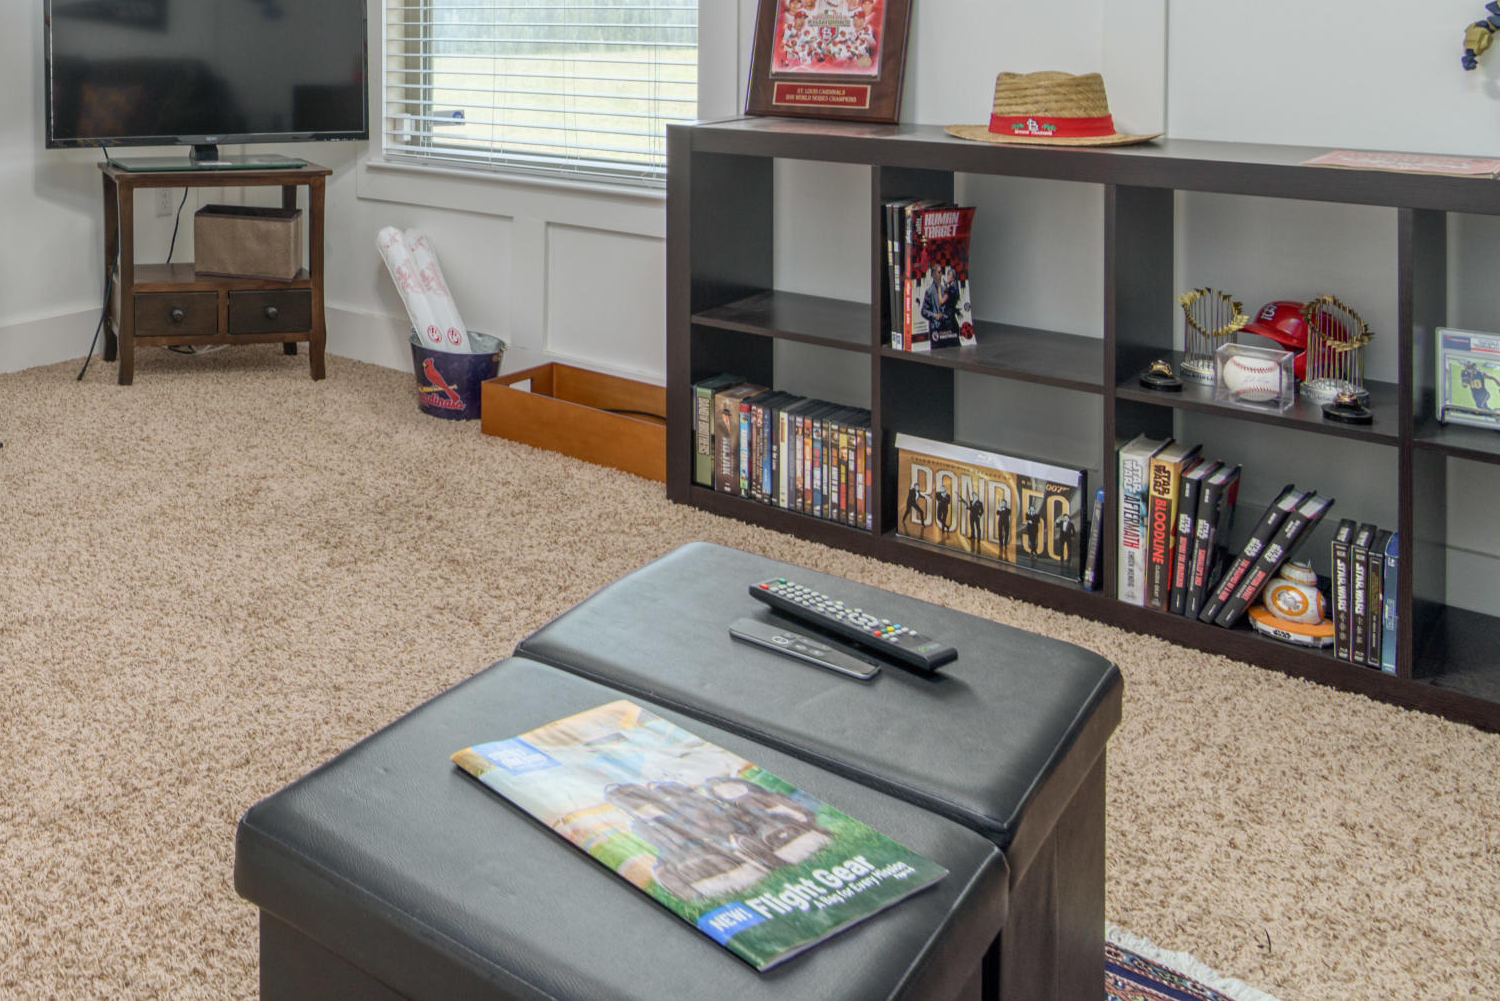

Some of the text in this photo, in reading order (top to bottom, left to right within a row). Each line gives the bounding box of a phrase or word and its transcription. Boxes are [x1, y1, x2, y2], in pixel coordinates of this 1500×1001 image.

[924, 212, 959, 226] HUMAN
[924, 225, 957, 238] TARGET
[1123, 460, 1133, 493] WARS
[1132, 461, 1142, 494] STAR
[1153, 464, 1163, 496] WARS
[1161, 467, 1171, 496] STAR
[910, 462, 1011, 544] BOND
[1021, 488, 1070, 561] 50
[1123, 495, 1140, 549] AFTERMATH
[1152, 499, 1167, 564] BLOODLINE
[1337, 559, 1347, 612] STAR WARS
[1355, 562, 1365, 616] STAR WARS
[848, 875, 881, 893] Every
[870, 861, 909, 880] Mission
[745, 855, 875, 920] Flight Gear
[818, 893, 846, 906] Bag
[708, 906, 754, 932] NEW!
[812, 899, 826, 910] A
